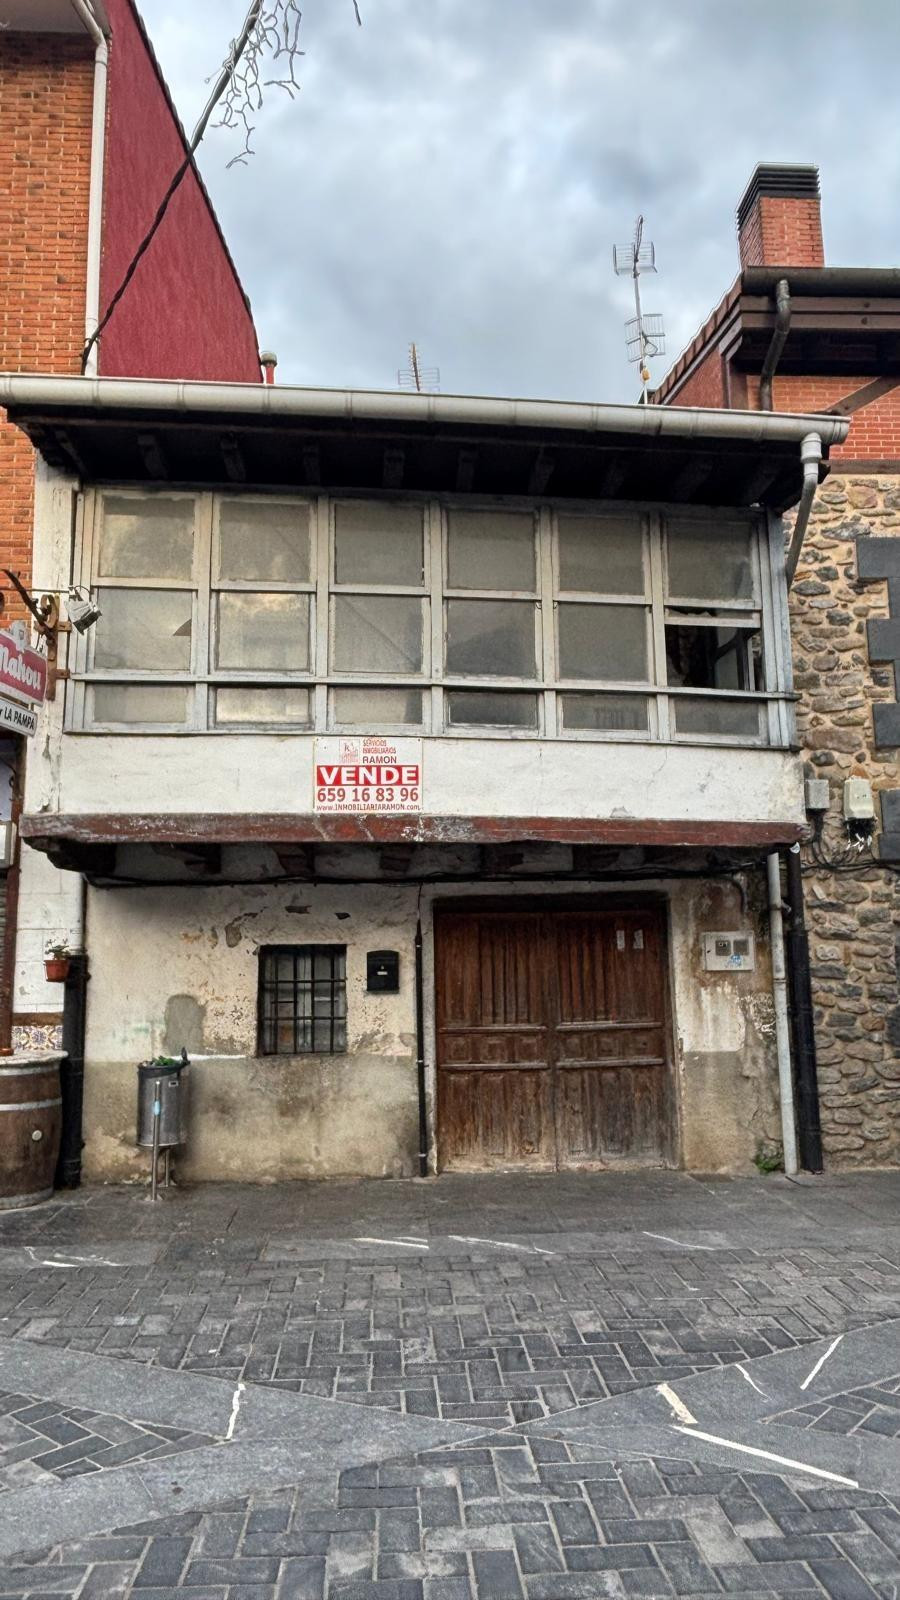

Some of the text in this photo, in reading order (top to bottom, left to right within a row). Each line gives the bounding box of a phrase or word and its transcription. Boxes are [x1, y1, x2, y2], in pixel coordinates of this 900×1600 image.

[4, 706, 12, 721] LA
[13, 710, 35, 730] PAMPA
[362, 755, 397, 764] RAMON
[319, 766, 417, 784] VENDE
[317, 787, 419, 802] 659 16 83 96
